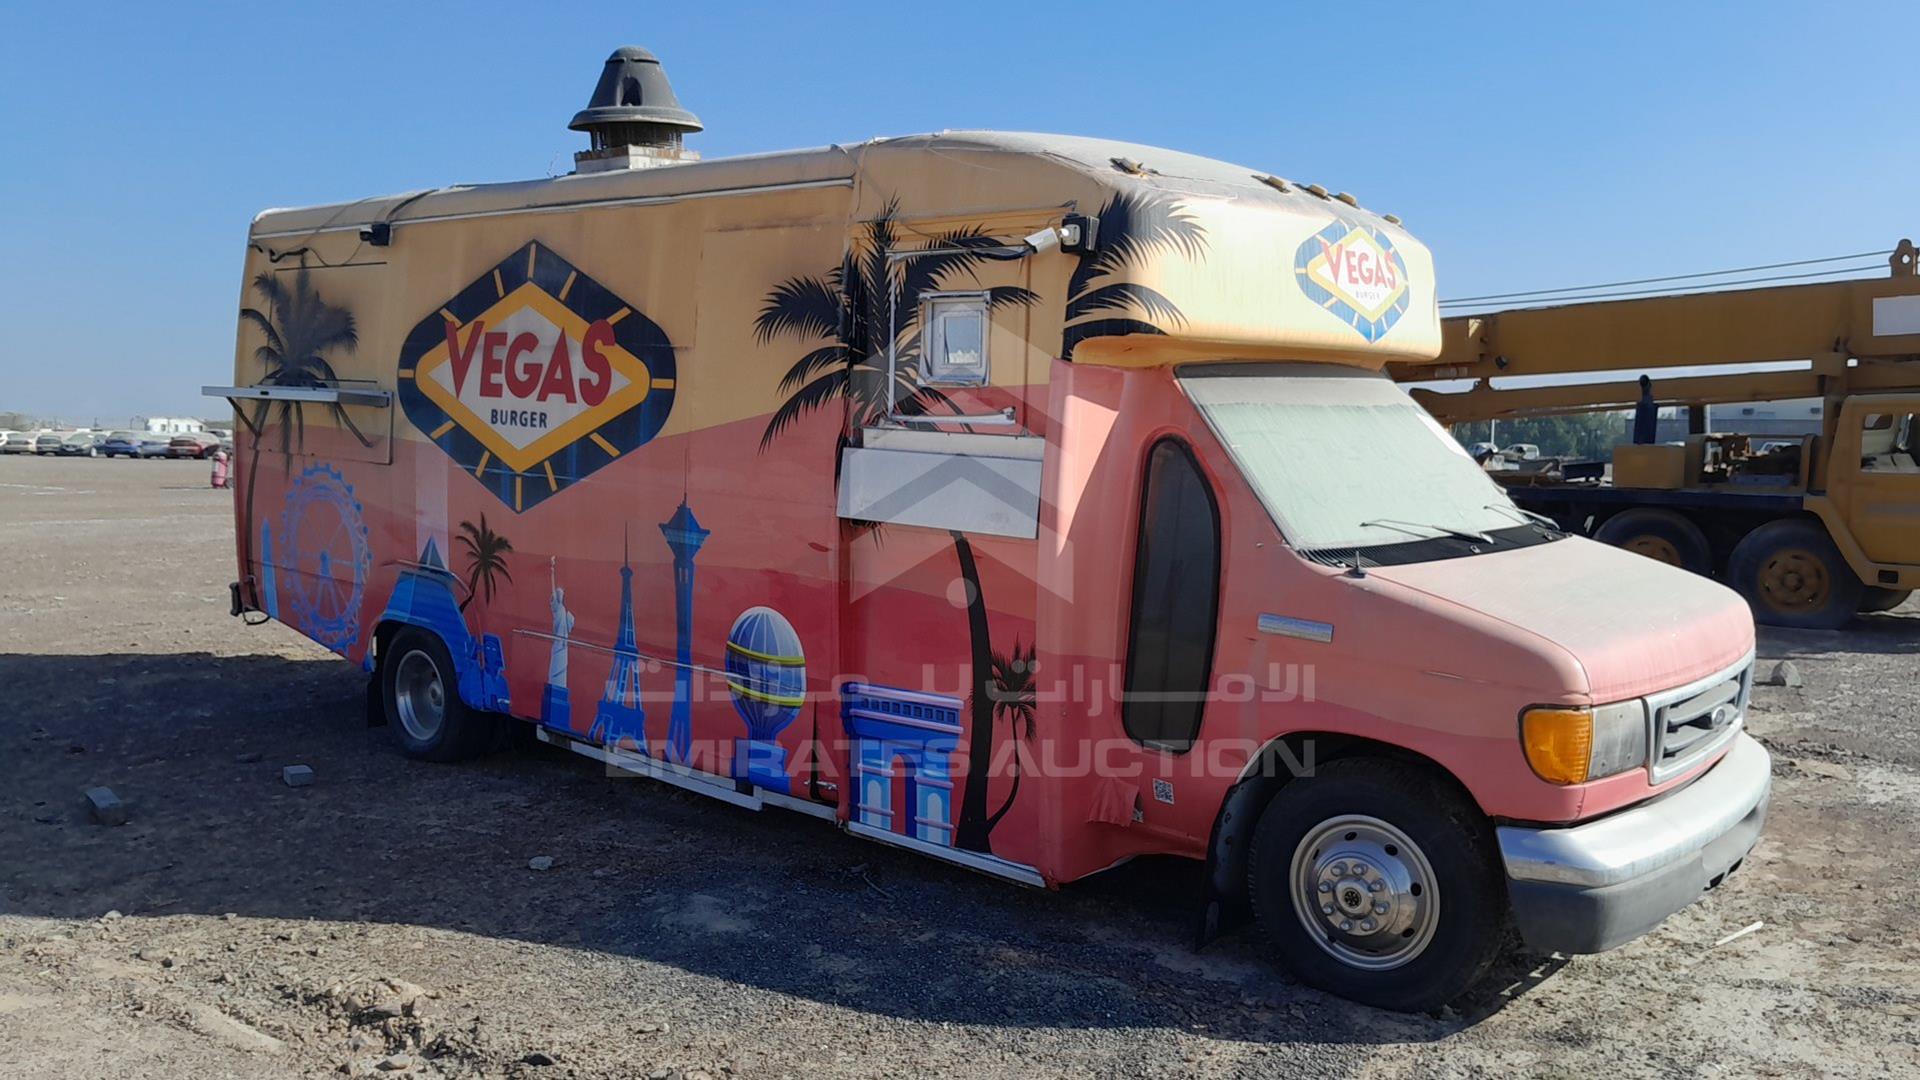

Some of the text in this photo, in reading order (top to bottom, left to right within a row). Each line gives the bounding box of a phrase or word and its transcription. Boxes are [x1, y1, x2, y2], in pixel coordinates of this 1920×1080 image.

[1320, 240, 1396, 291] VEGAS
[445, 319, 616, 407] VEGAS
[490, 408, 548, 429] BURGER
